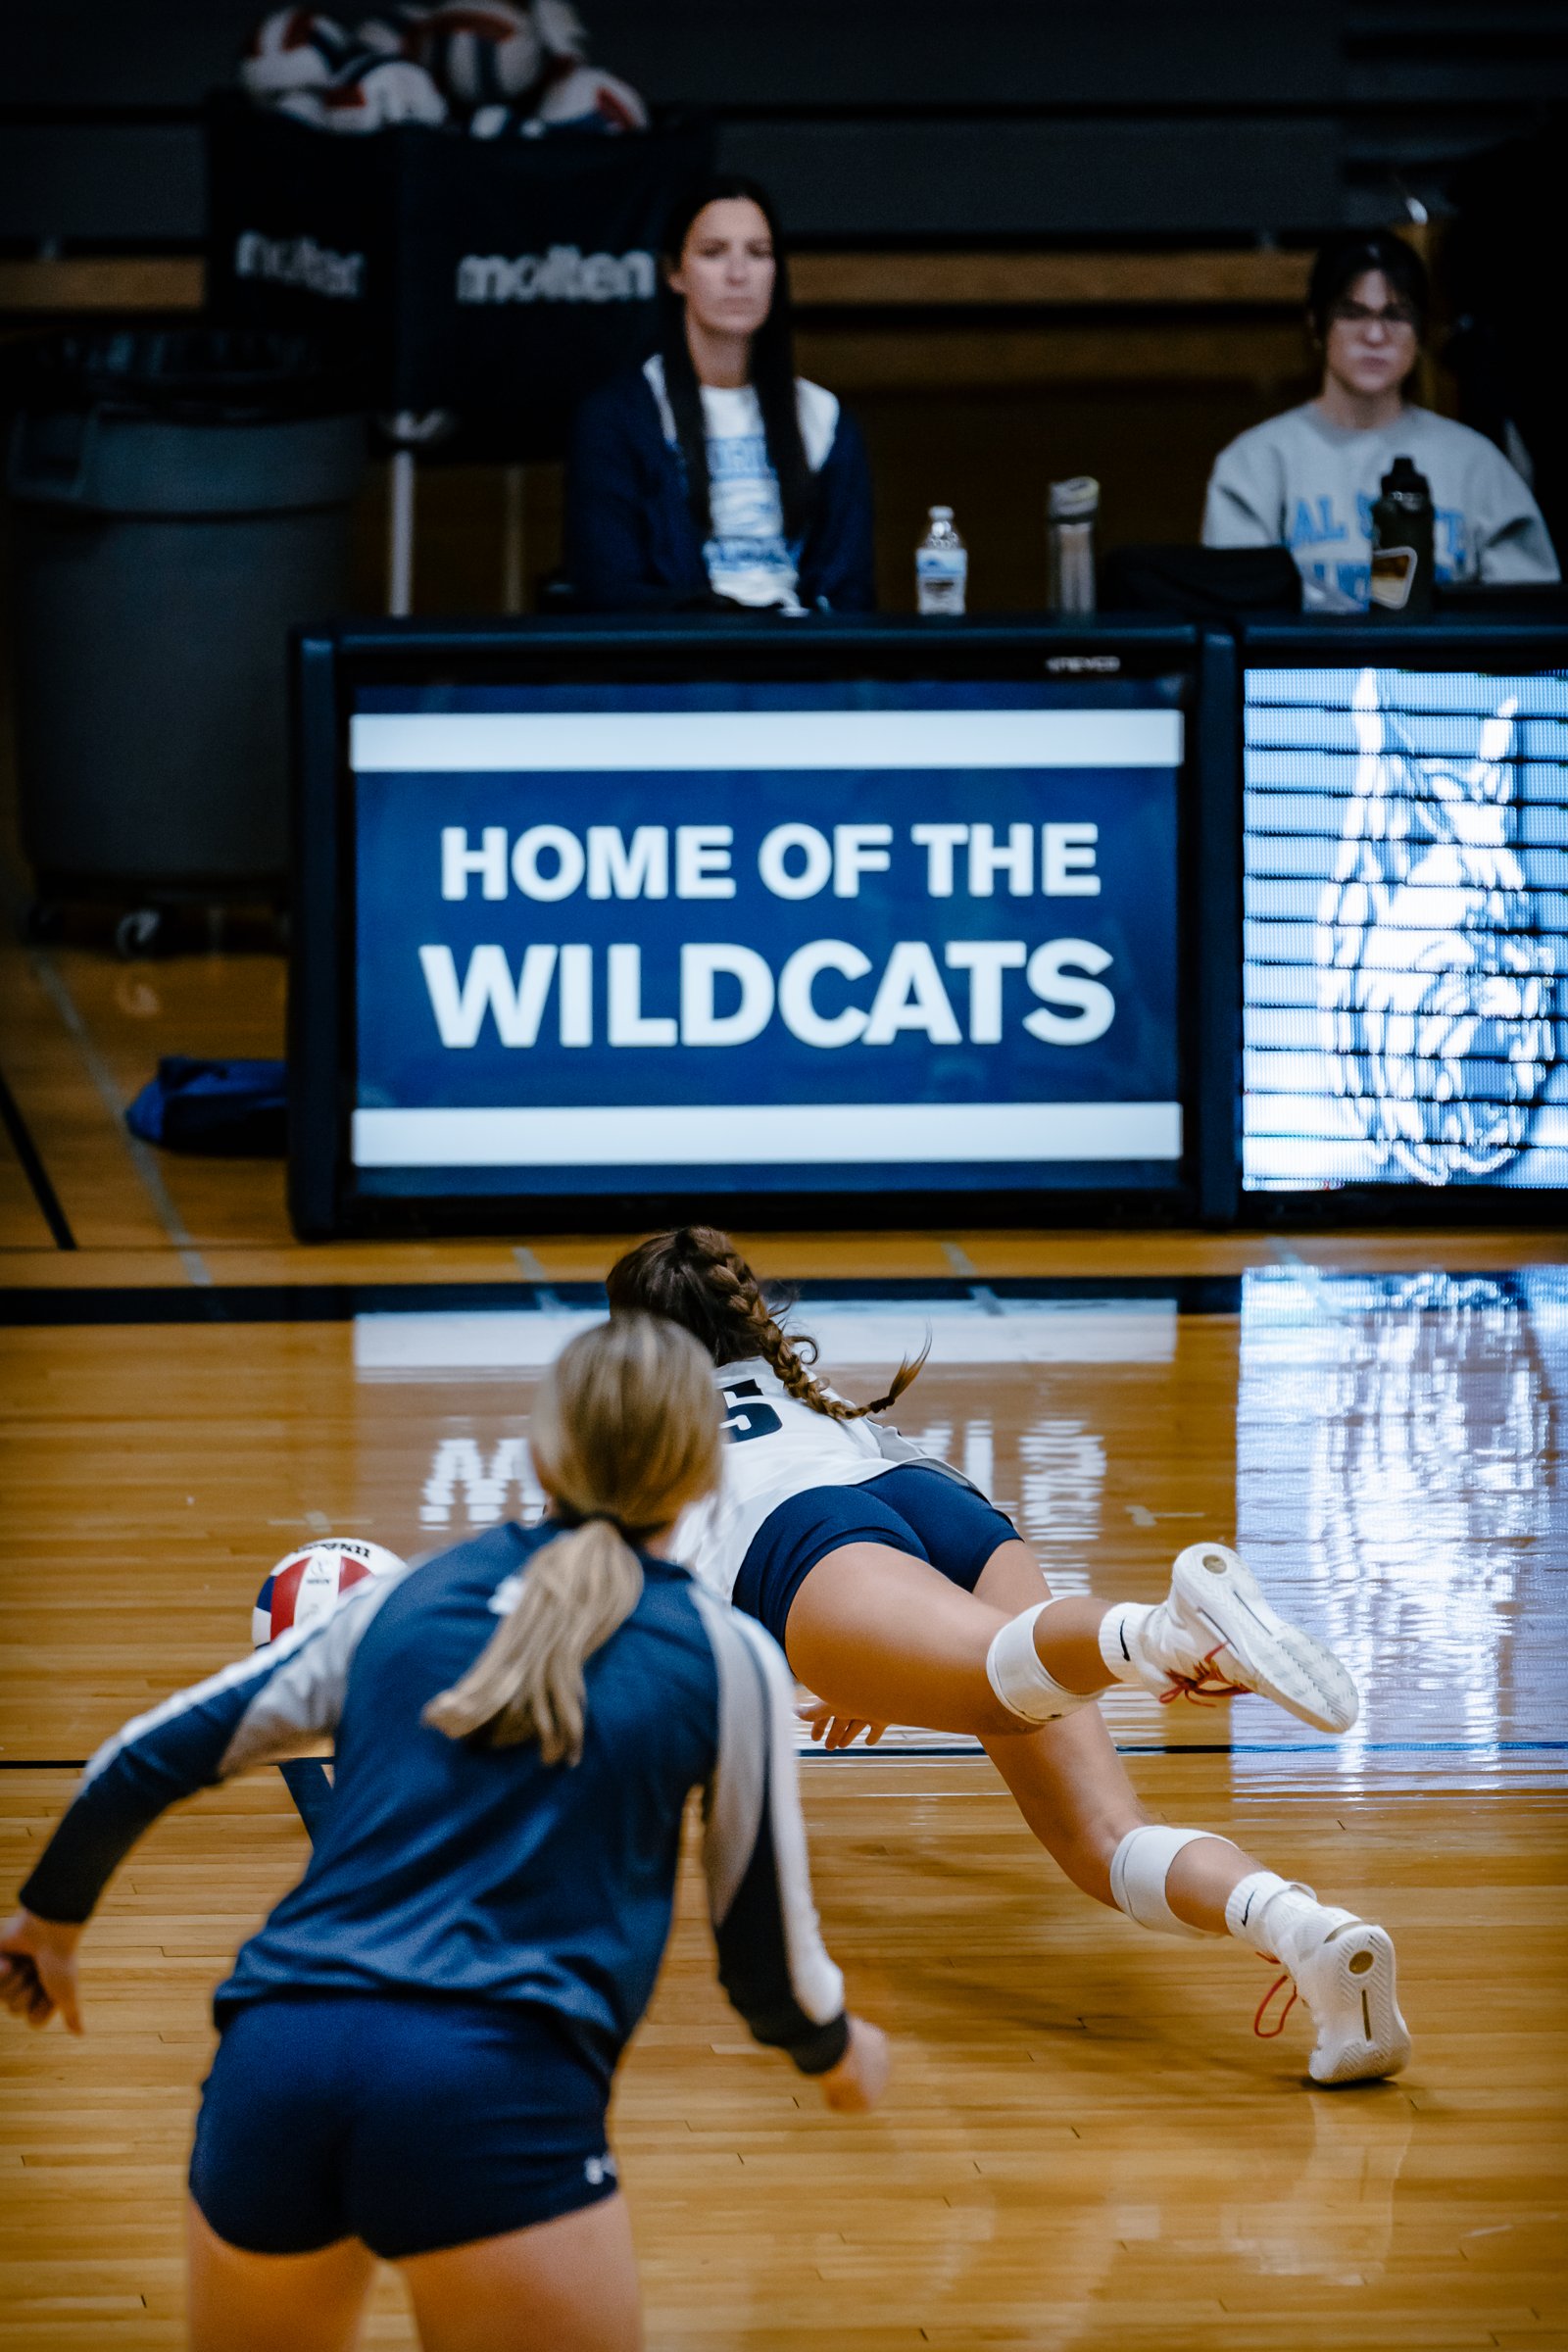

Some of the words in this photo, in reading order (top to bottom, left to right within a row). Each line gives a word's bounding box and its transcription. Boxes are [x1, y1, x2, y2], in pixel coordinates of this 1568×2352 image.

[442, 824, 736, 902] HOME
[759, 822, 893, 900] OF
[911, 822, 1102, 898] THE
[419, 938, 1115, 1048] WILDCATS
